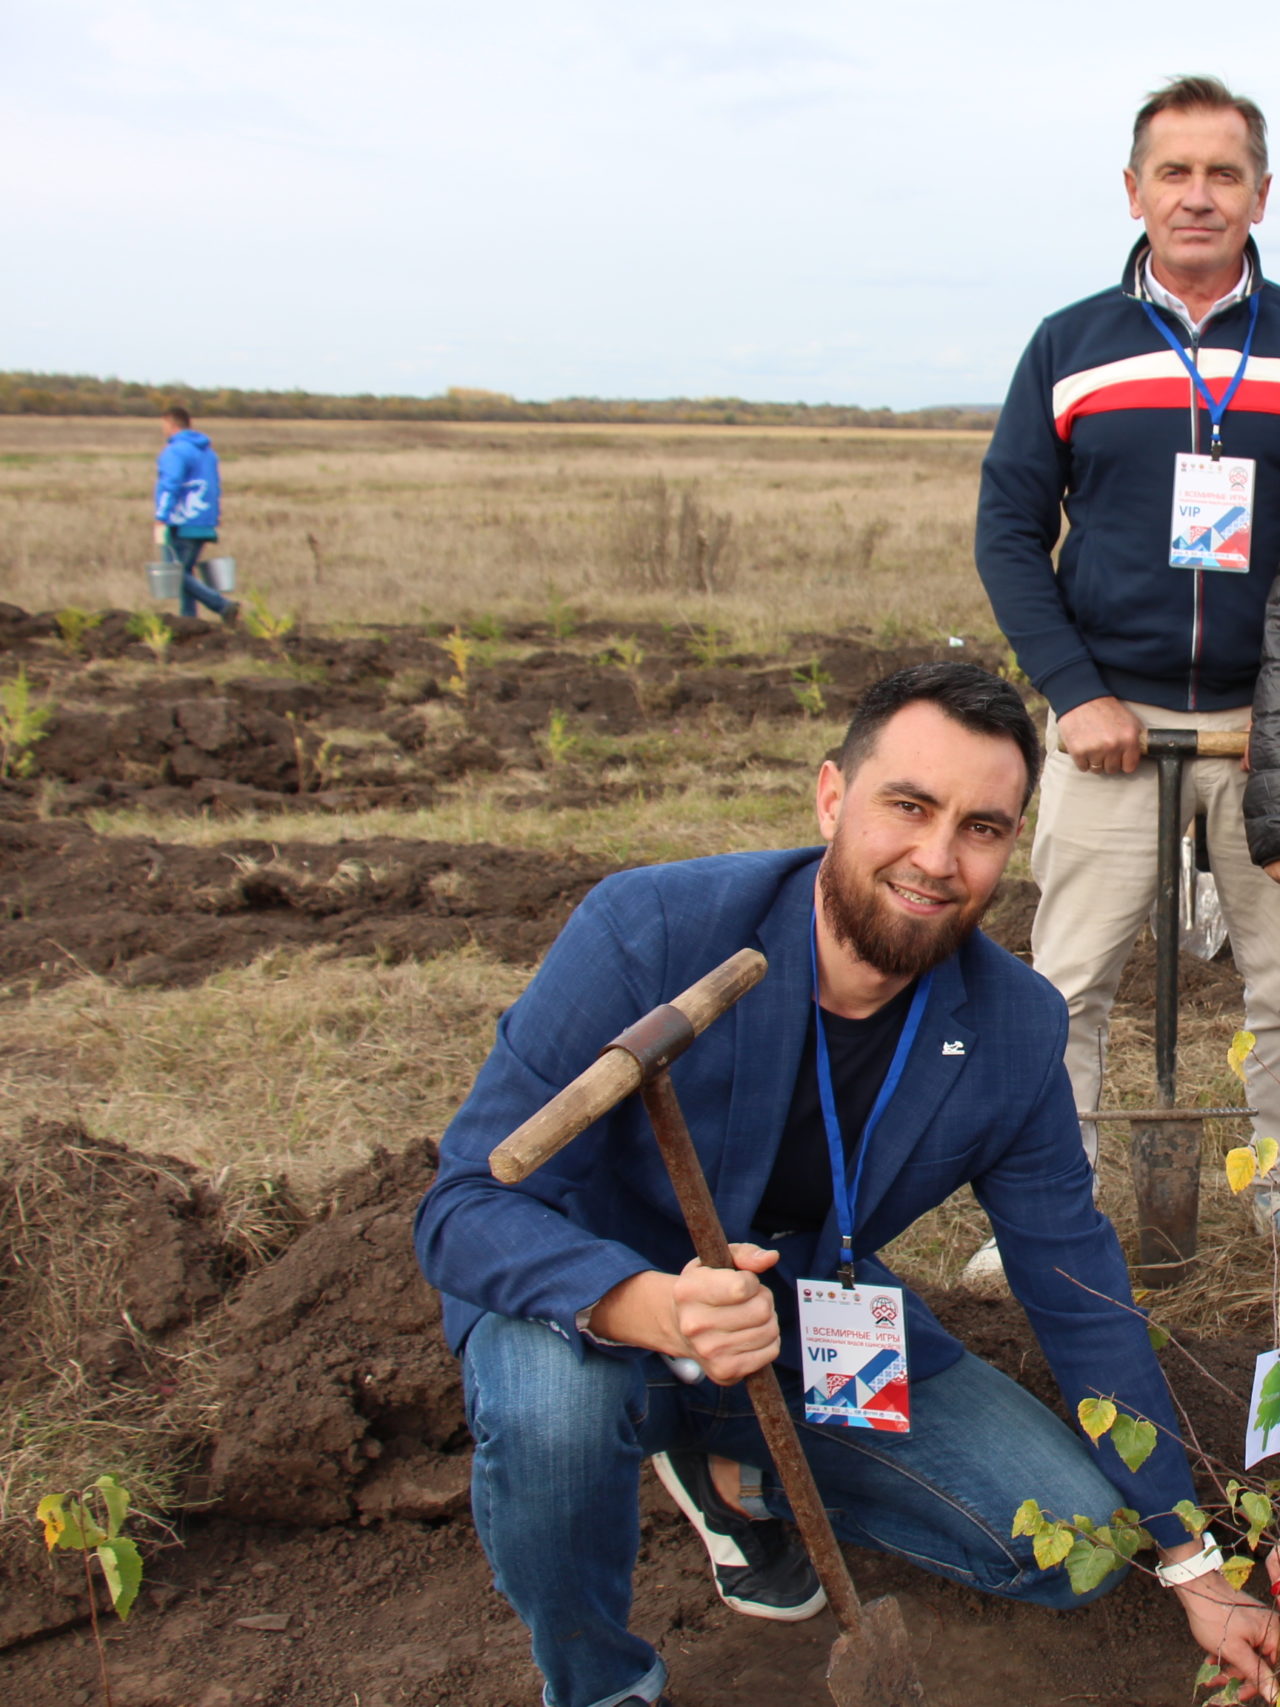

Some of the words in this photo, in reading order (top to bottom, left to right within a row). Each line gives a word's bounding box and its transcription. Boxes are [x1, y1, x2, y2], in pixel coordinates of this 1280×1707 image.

[1179, 505, 1200, 517] VIP
[813, 1327, 871, 1340] ВСЕМИРНЫЕ
[876, 1333, 900, 1342] ИГРЫ
[808, 1347, 838, 1362] VIP
